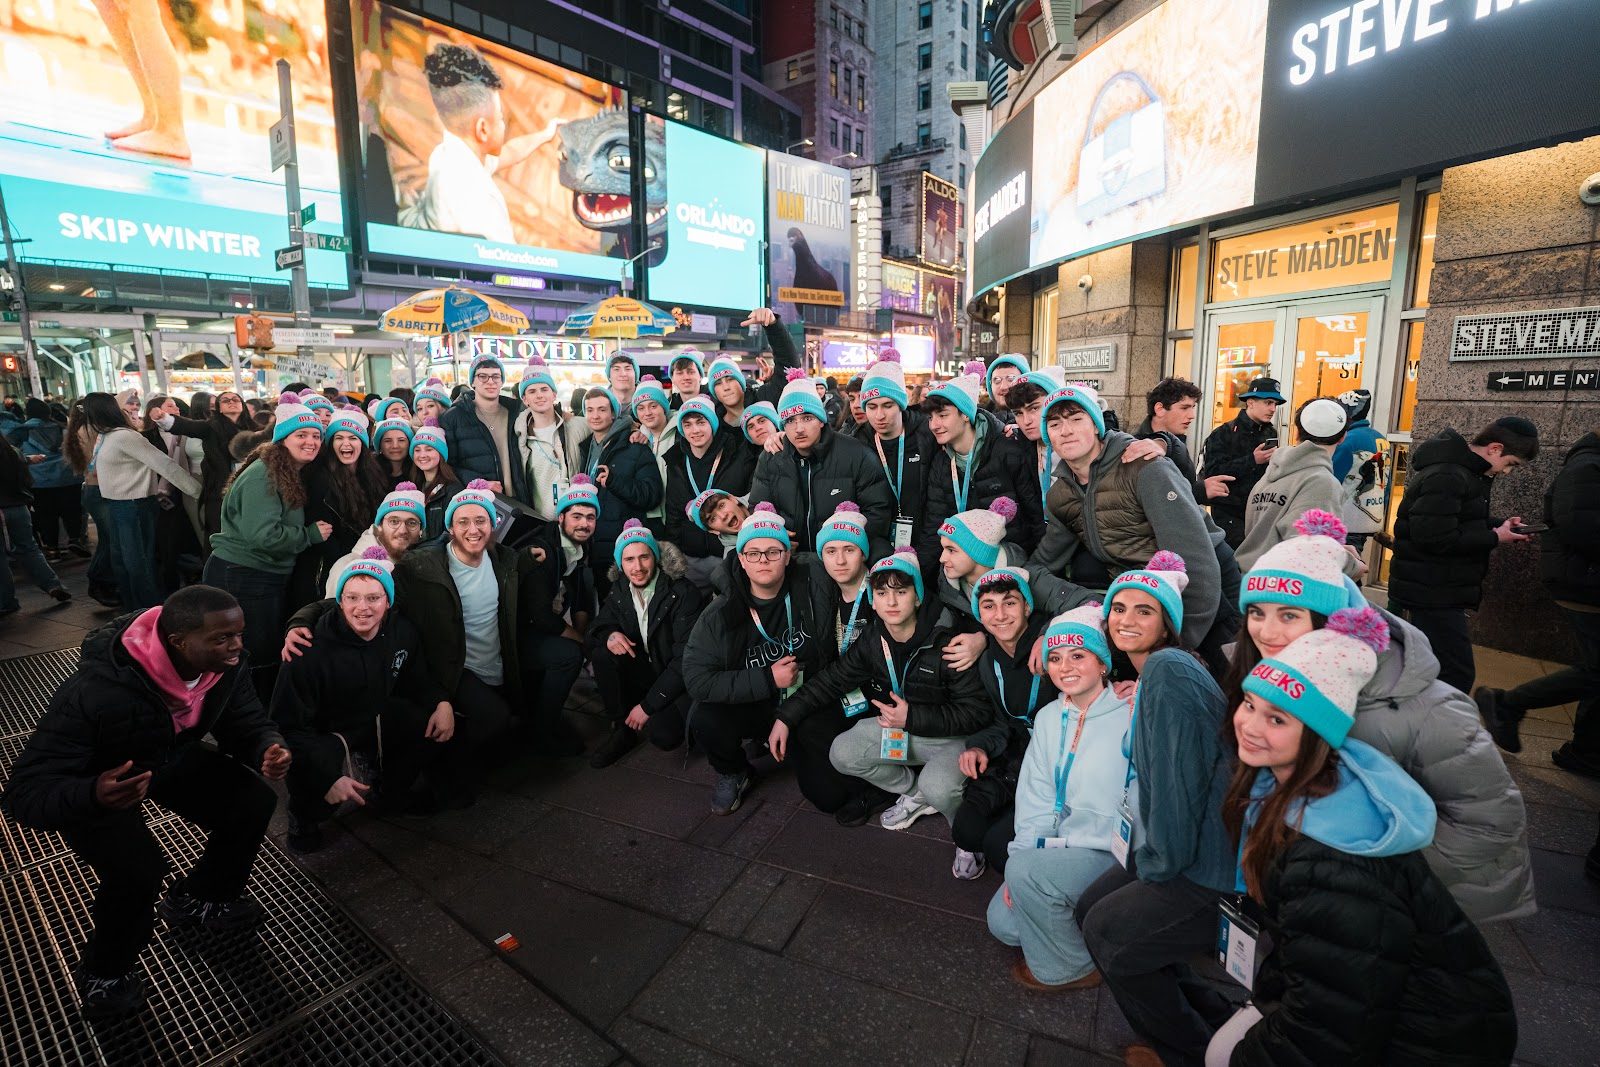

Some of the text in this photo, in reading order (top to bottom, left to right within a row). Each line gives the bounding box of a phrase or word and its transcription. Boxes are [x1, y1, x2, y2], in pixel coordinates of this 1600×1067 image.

[1289, 0, 1448, 86] STEVE
[776, 161, 788, 191] IT
[819, 172, 845, 203] JUST
[926, 180, 957, 201] ALDO
[675, 202, 756, 238] ORLANDO
[776, 190, 845, 231] MANHATTAN
[58, 211, 261, 258] SKIP WINTER
[318, 235, 327, 249] W
[329, 237, 342, 250] 42
[1219, 227, 1391, 284] STEVE MADDEN
[388, 317, 441, 332] SABRETT
[600, 315, 650, 323] SABRETT
[517, 338, 578, 360] OVER
[1457, 321, 1553, 351] STEVE
[1083, 350, 1110, 367] SQUARE
[1246, 576, 1304, 597] BUCKS
[745, 622, 812, 670] HUG
[1251, 663, 1307, 700] BUCKS
